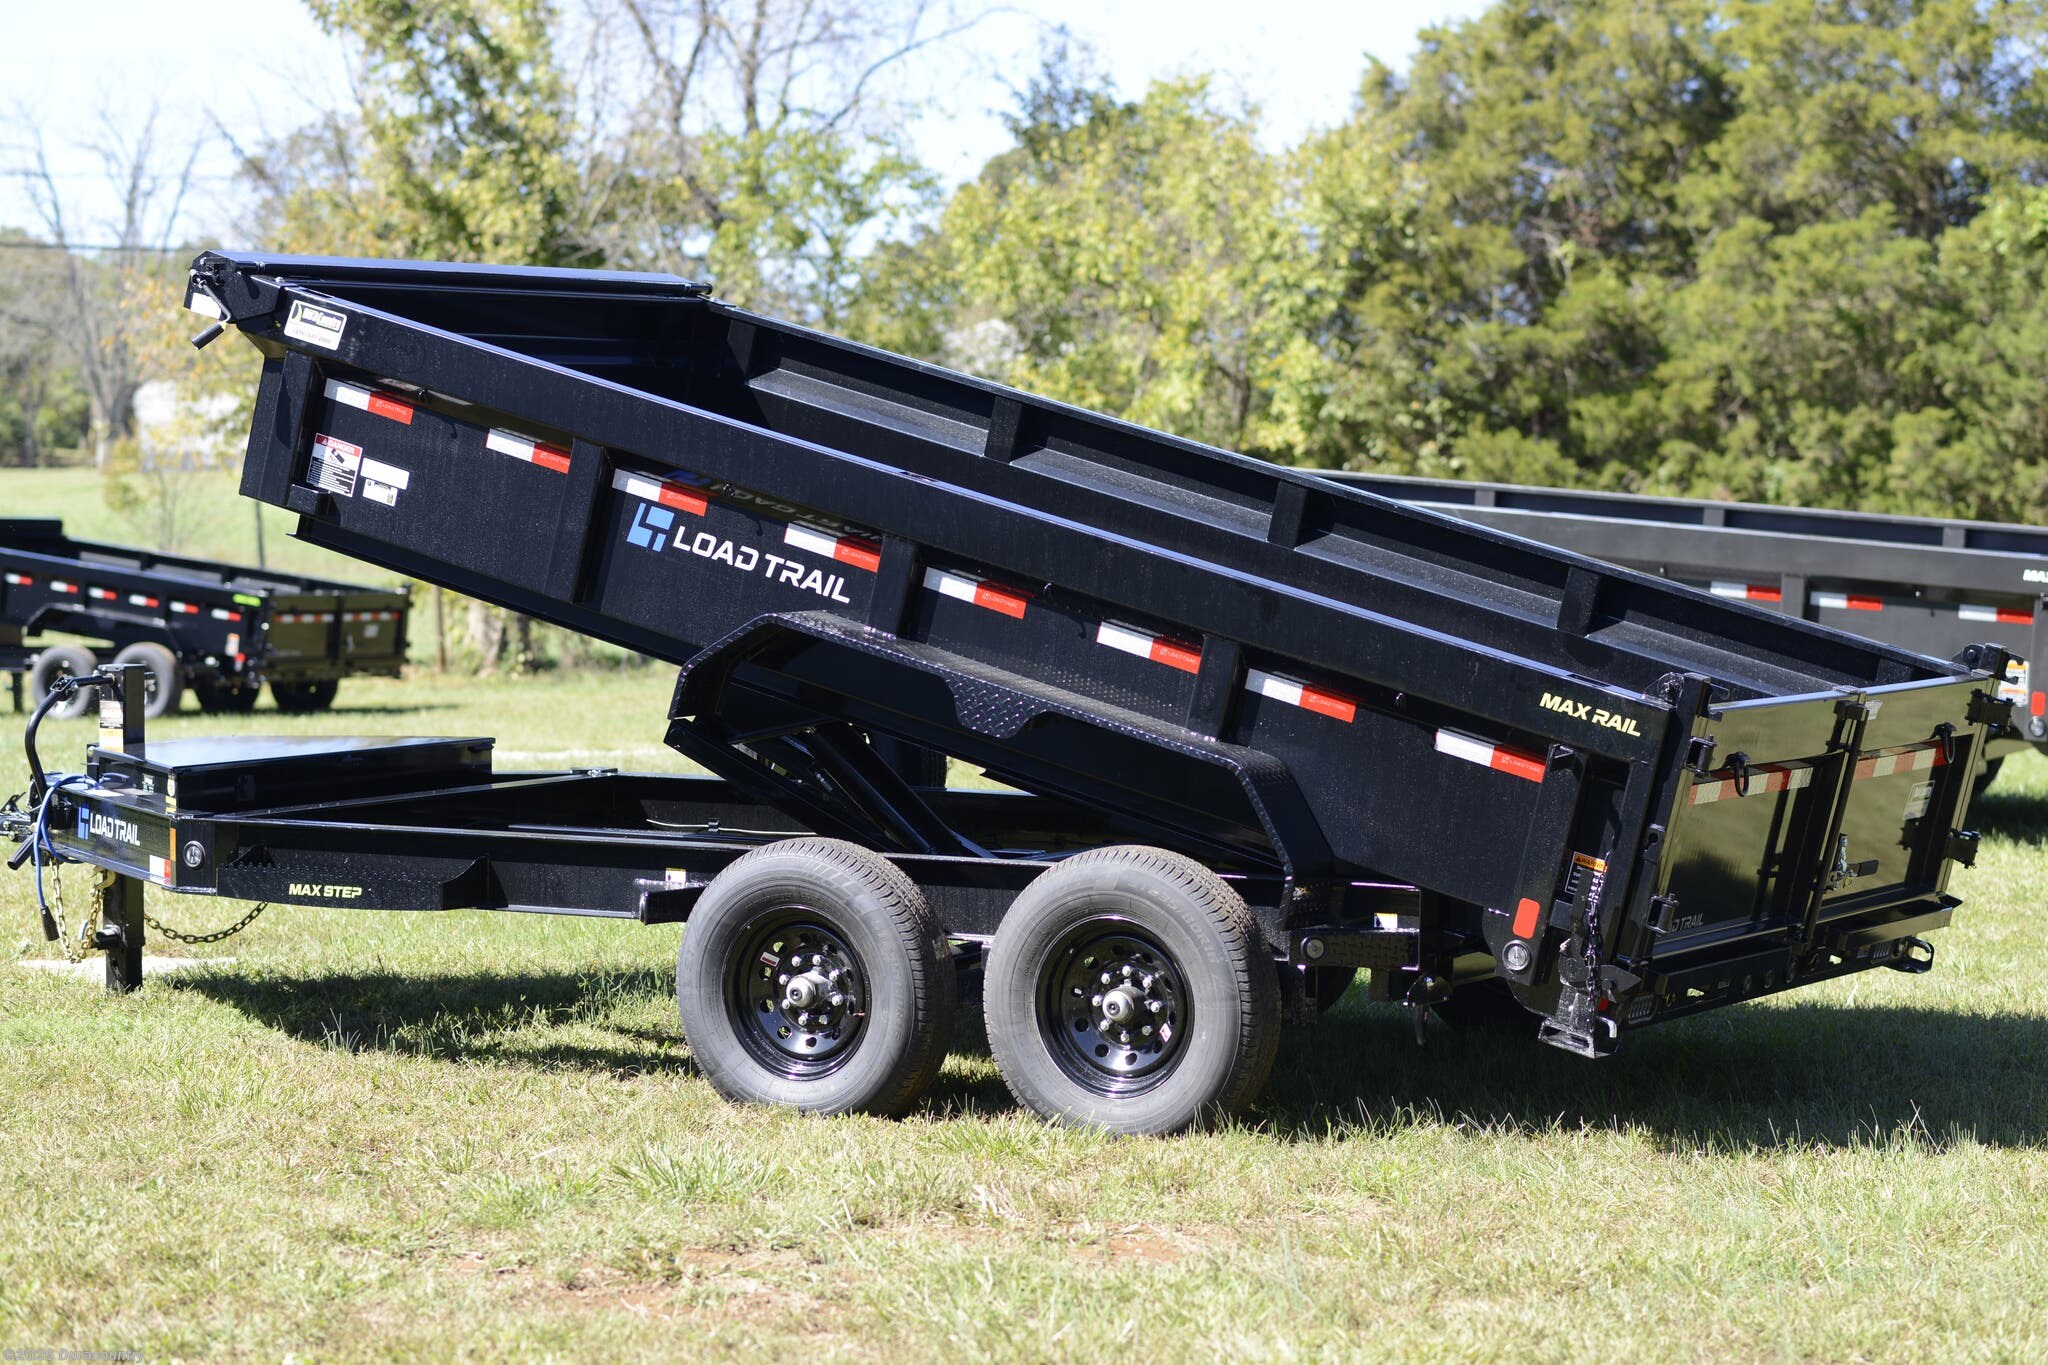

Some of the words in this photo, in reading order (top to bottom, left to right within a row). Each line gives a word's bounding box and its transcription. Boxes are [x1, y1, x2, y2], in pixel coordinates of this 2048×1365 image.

[328, 440, 355, 455] DANGER
[672, 525, 760, 572] LOAD
[764, 553, 850, 604] TRAIL
[1540, 692, 1592, 720] MAX
[1591, 708, 1641, 737] RAIL
[90, 812, 114, 839] LOAD
[114, 818, 141, 847] TRAIL
[288, 883, 322, 897] MAX
[323, 885, 363, 899] STEP
